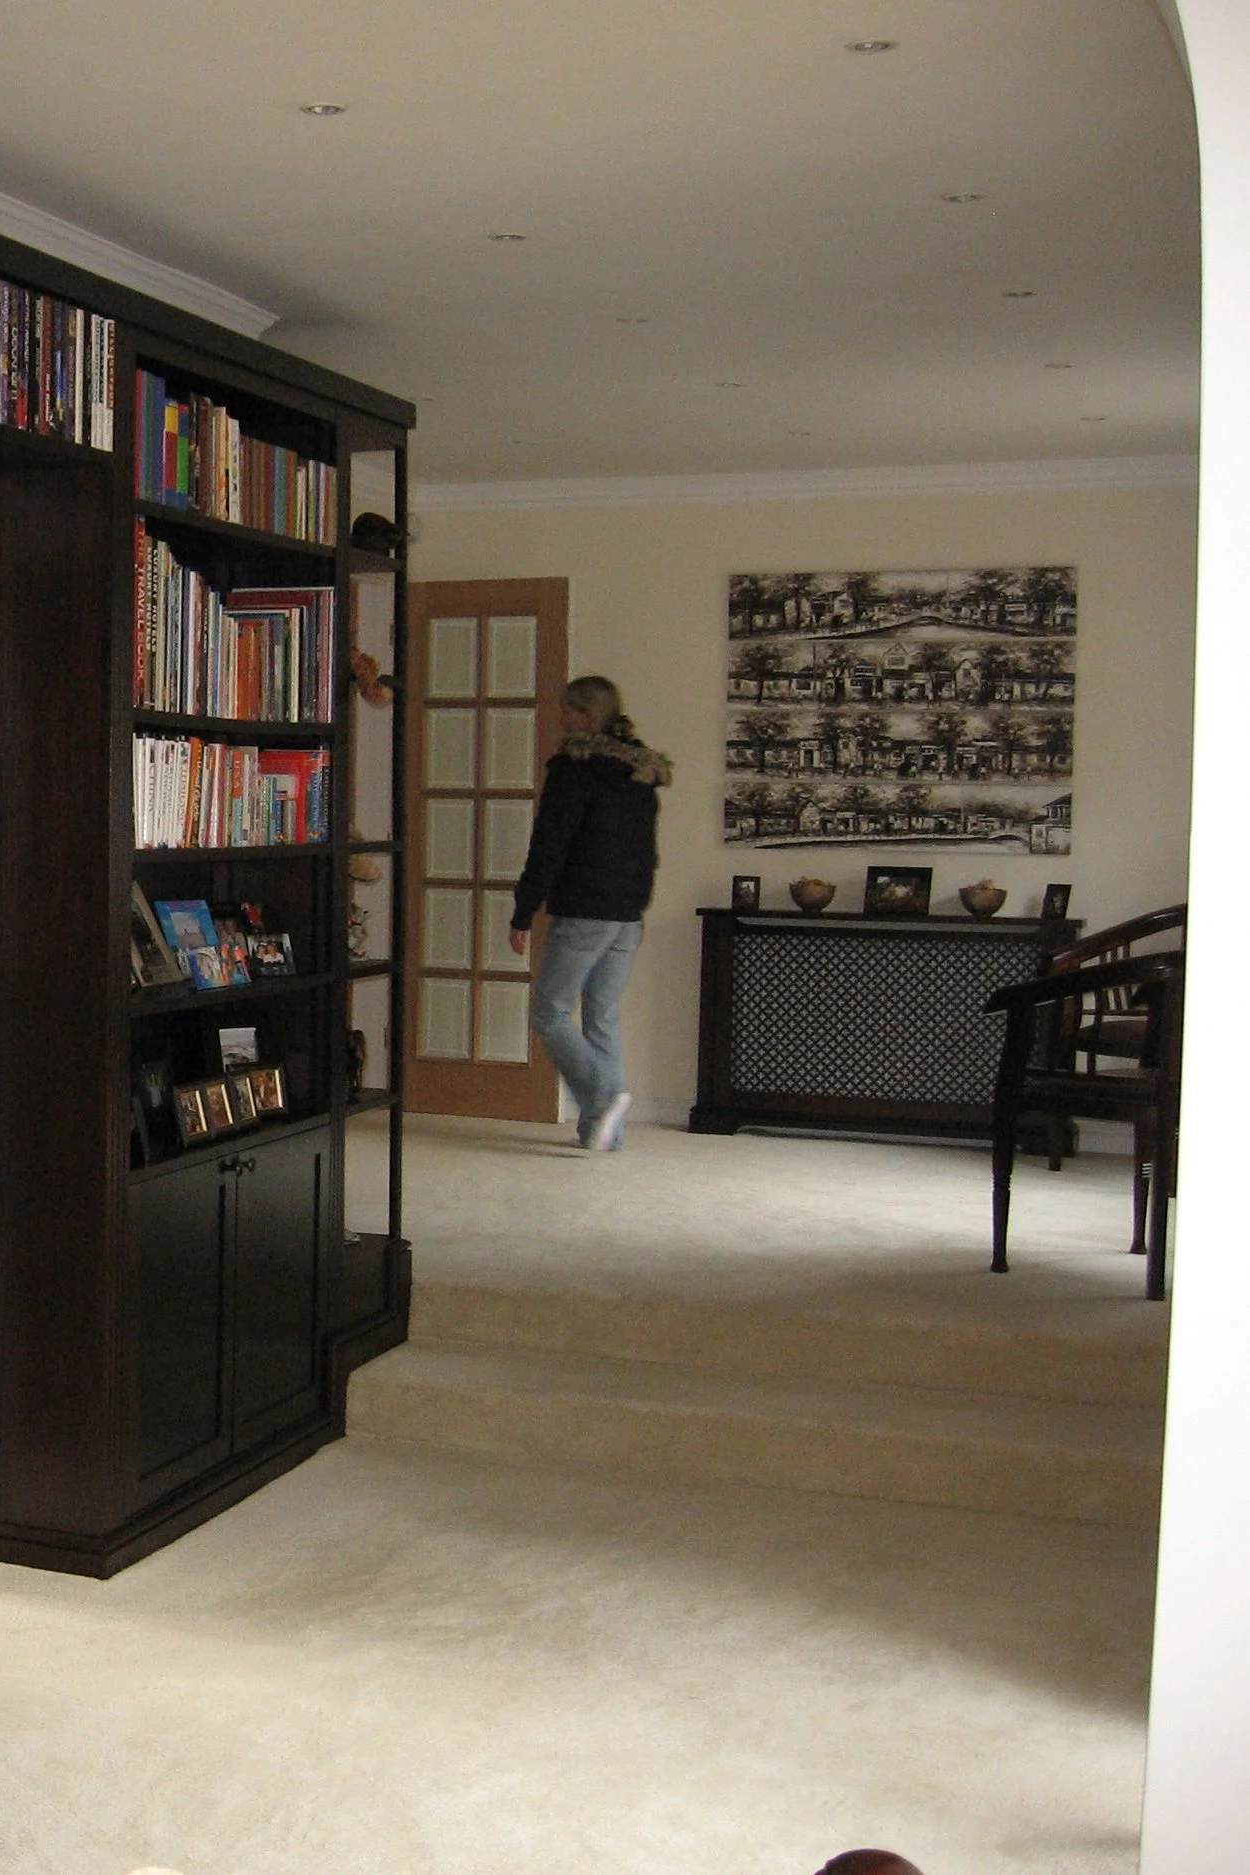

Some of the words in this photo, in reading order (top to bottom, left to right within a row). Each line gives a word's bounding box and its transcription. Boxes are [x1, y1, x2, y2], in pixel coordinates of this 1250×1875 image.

[137, 566, 146, 630] TRAVEL
[137, 630, 145, 682] BOOK
[148, 764, 156, 813] CHINA
